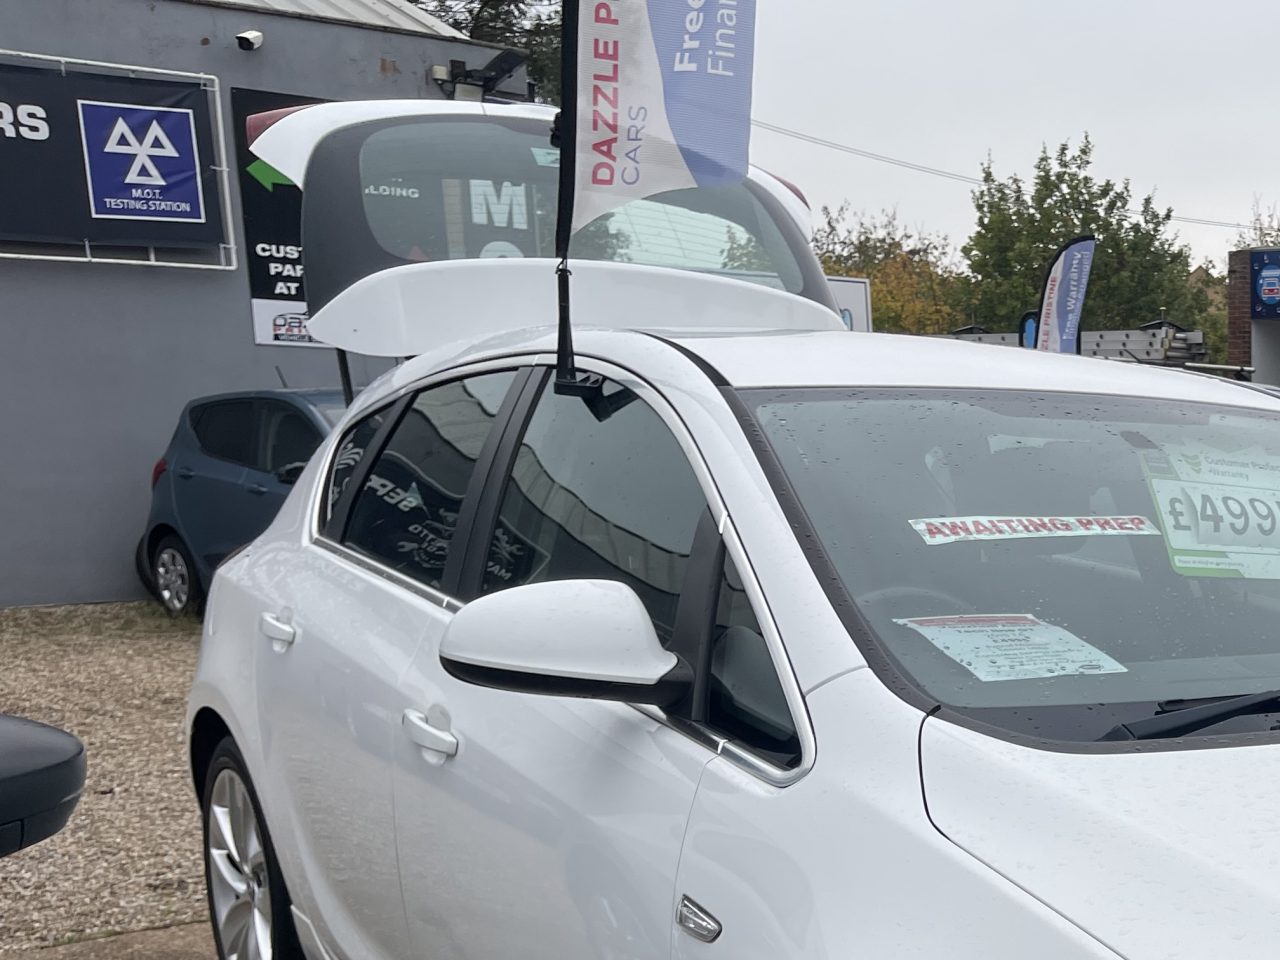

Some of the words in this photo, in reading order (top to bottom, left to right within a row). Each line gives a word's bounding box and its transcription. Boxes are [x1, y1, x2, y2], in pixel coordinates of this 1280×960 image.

[592, 38, 619, 186] DAZZLE
[621, 106, 648, 185] CARS
[104, 198, 148, 210] TESTING
[148, 200, 191, 212] STATION
[274, 281, 300, 295] AT
[926, 517, 1072, 539] AWAITING
[1075, 516, 1145, 531] PREP
